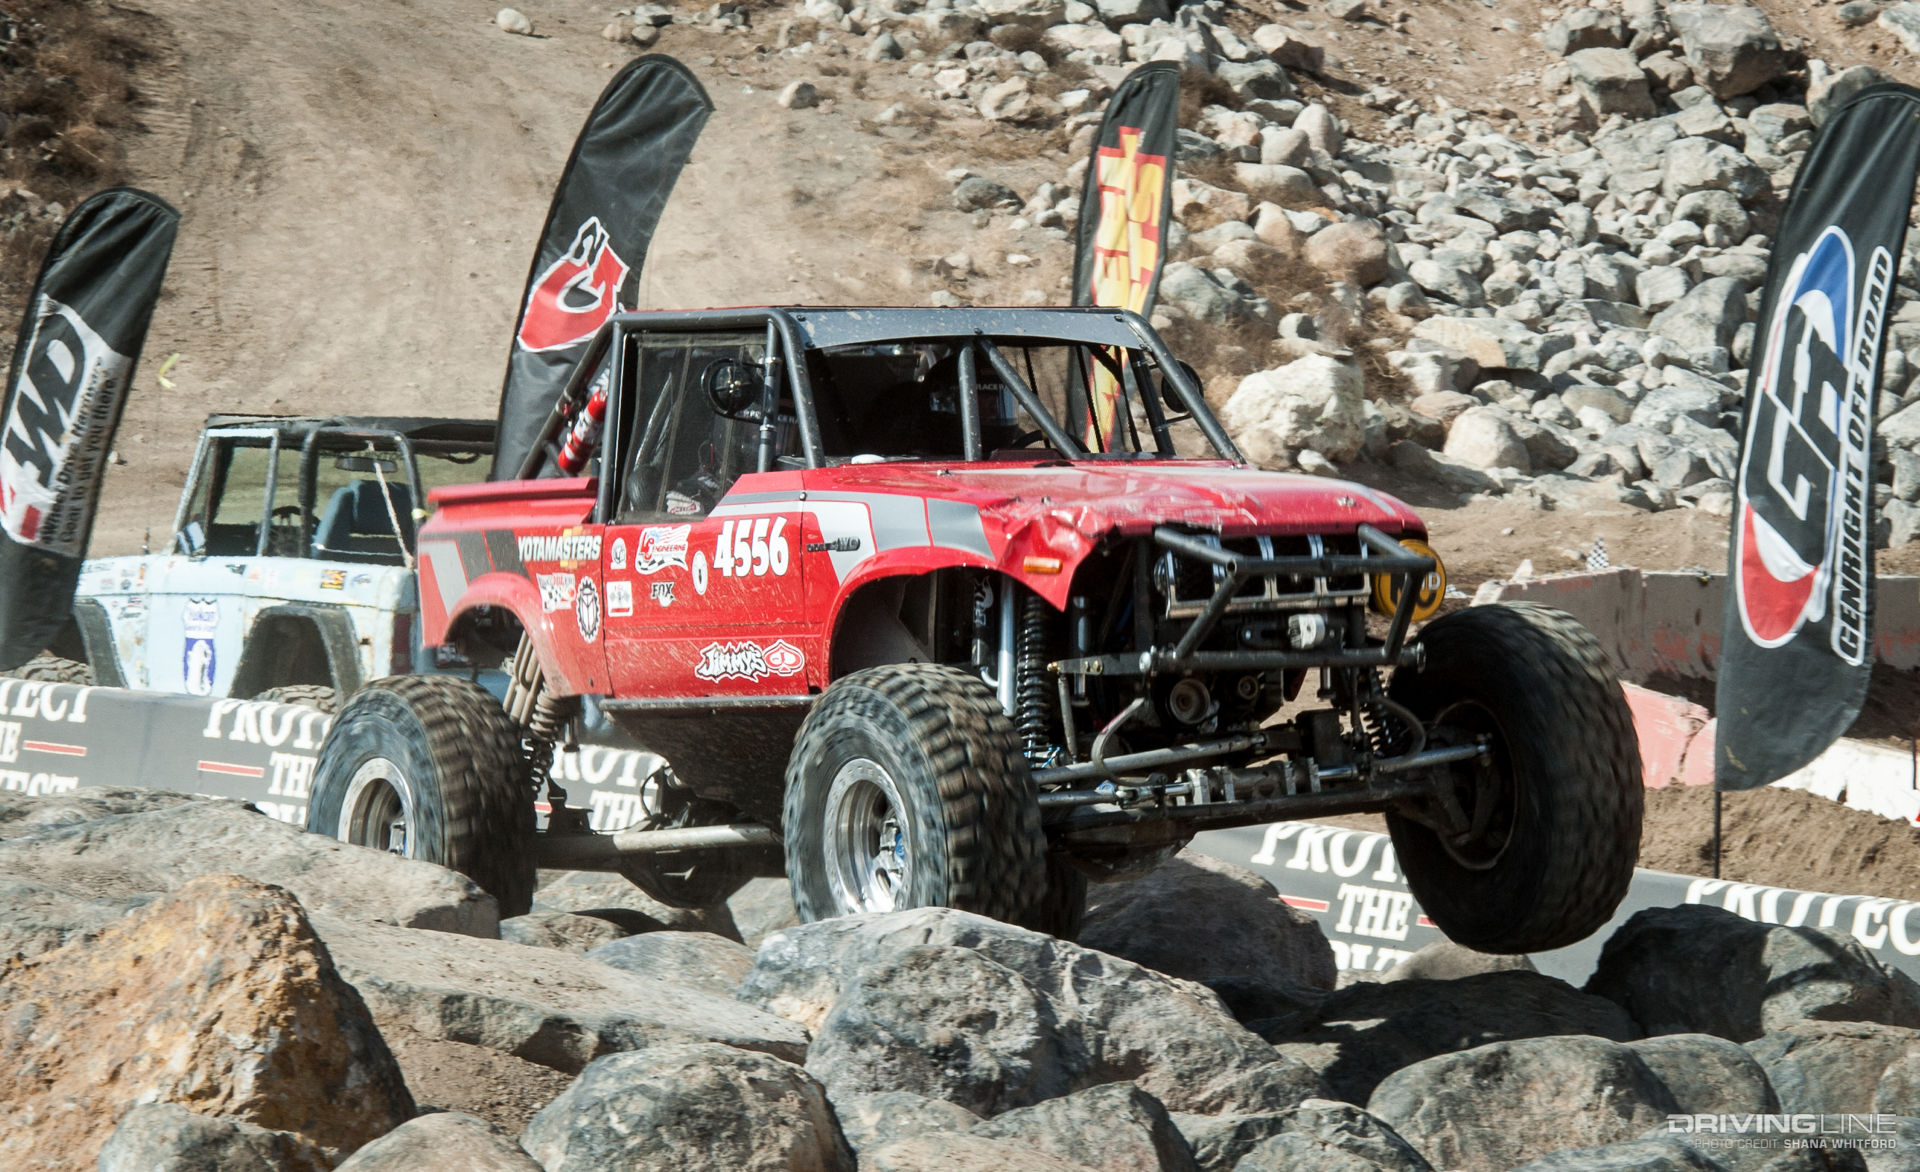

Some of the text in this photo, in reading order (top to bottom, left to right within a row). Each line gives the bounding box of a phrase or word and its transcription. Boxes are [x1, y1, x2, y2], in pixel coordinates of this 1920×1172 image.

[83, 424, 108, 455] you
[1745, 302, 1848, 570] GR
[55, 441, 81, 485] Drive
[76, 453, 99, 483] get
[1839, 258, 1888, 659] GENRIGHT OFF ROAD
[70, 484, 87, 503] to
[59, 505, 83, 544] Gear
[713, 516, 789, 577] 4556
[518, 535, 601, 562] YOTAMASTERS
[652, 543, 686, 553] ENGINEERING
[651, 582, 673, 598] FOX
[0, 678, 108, 723] TECT
[203, 698, 333, 750] PROT
[1250, 820, 1409, 884] PROT
[1335, 883, 1413, 941] THE
[1685, 878, 1920, 956] PROTEC
